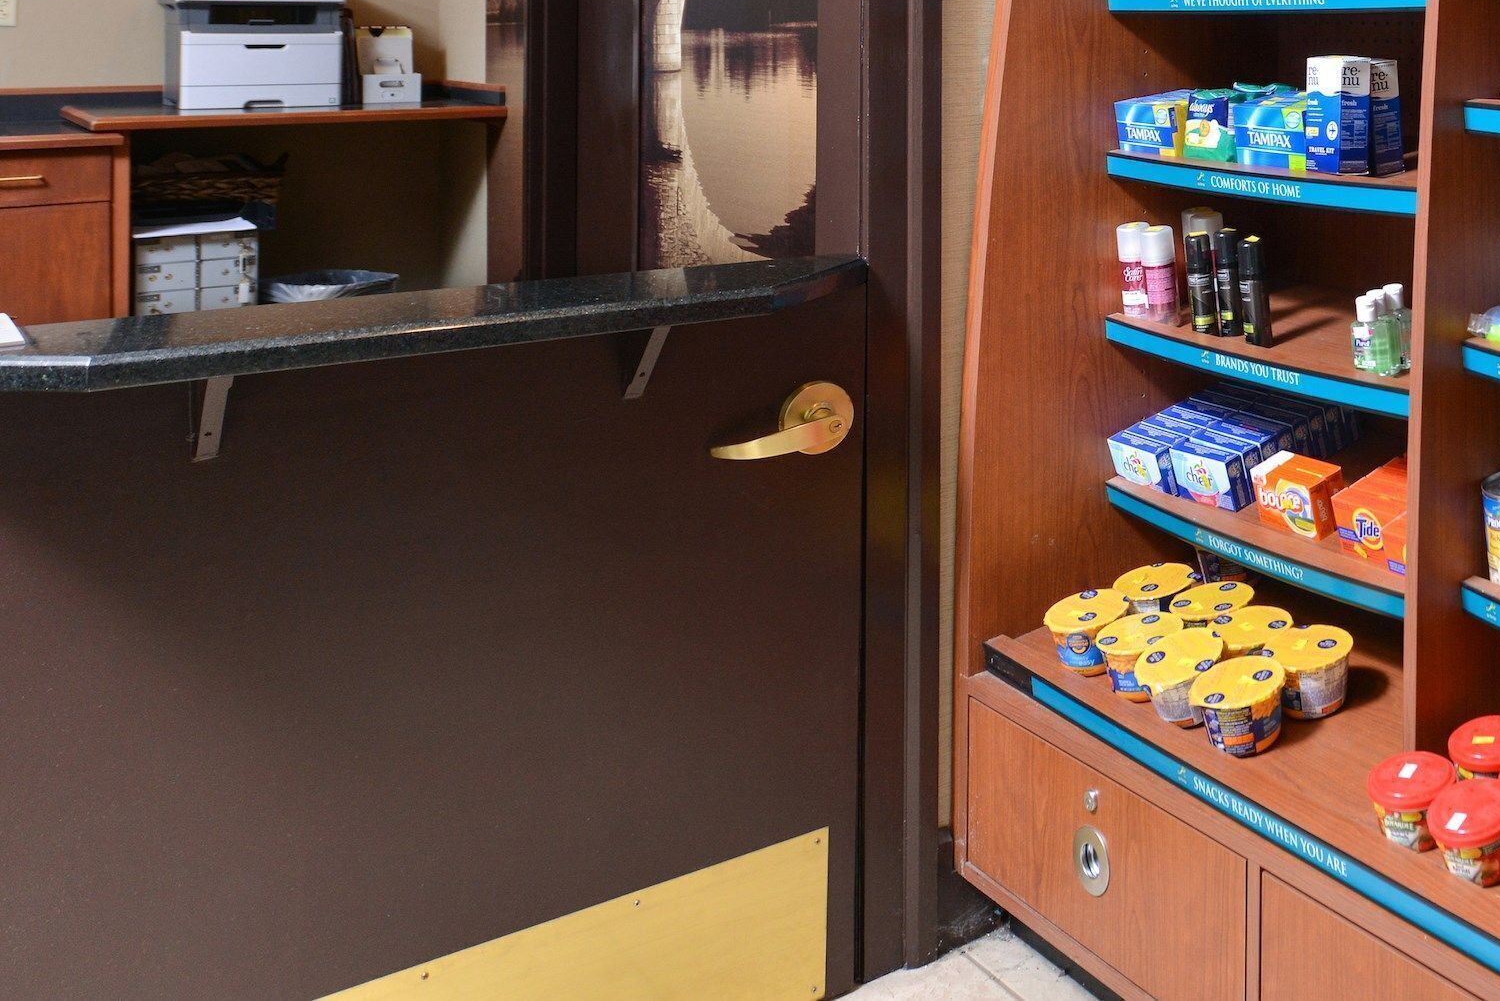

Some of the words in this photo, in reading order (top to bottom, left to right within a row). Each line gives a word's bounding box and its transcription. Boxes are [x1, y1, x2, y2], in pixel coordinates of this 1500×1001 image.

[1343, 76, 1360, 85] nu
[1372, 81, 1389, 91] nu
[1126, 126, 1161, 142] TAMPAX
[1248, 131, 1292, 149] TAMPAX
[1210, 175, 1257, 194] COMFORTS
[1258, 180, 1270, 195] OF
[1272, 182, 1300, 198] HOME
[1215, 354, 1249, 374] BRANDS
[1250, 360, 1269, 378] YOU
[1270, 367, 1300, 386] TRUST
[1355, 517, 1380, 539] Tide
[1208, 535, 1243, 559] FORGOT
[1244, 547, 1304, 581] SOMETHING?
[1193, 776, 1230, 808] SNACKS
[1231, 797, 1264, 829] READY
[1265, 817, 1298, 847] WHEN
[1299, 837, 1324, 863] YOU
[1326, 853, 1348, 877] ARE
